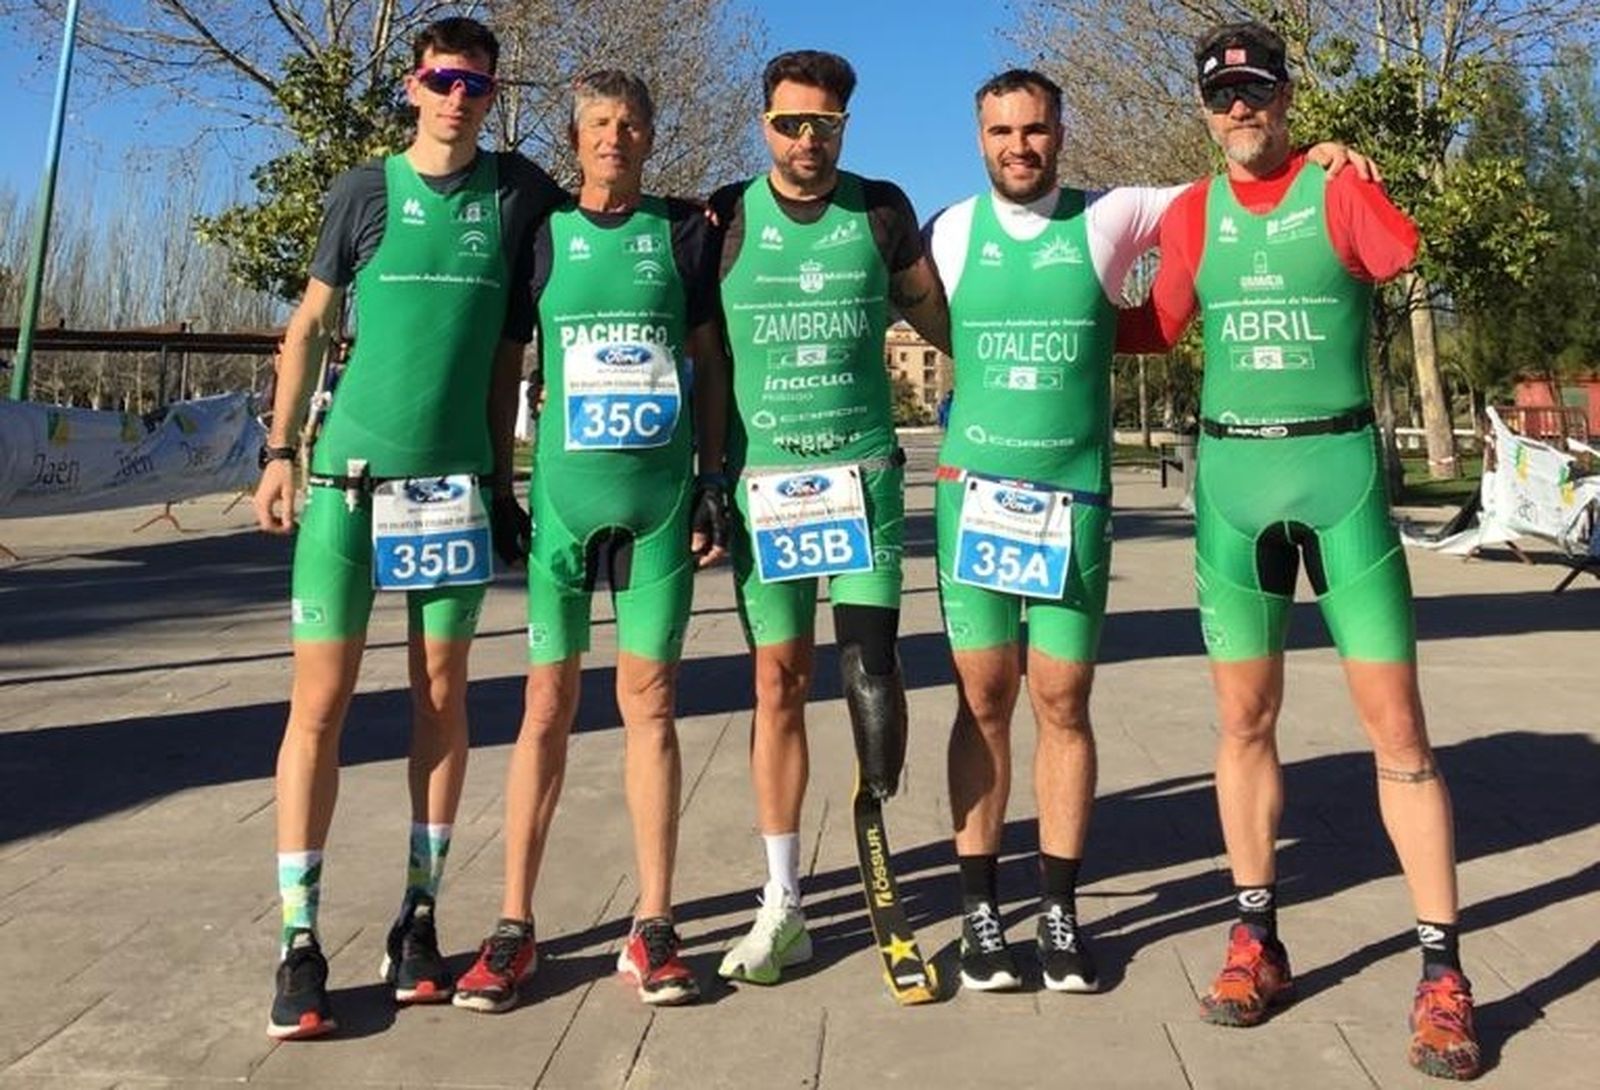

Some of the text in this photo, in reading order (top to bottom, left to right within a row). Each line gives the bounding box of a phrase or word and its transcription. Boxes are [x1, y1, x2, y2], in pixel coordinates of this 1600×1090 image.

[560, 324, 668, 348] PACHECO
[753, 310, 871, 343] ZAMBRANA
[1221, 311, 1326, 341] ABRIL
[977, 332, 1078, 362] OTALECU
[763, 371, 854, 391] inacua
[583, 402, 662, 438] 35C
[1001, 492, 1036, 511] Ford
[392, 540, 475, 579] 35D
[774, 529, 853, 570] 35B
[971, 540, 1049, 587] 35A
